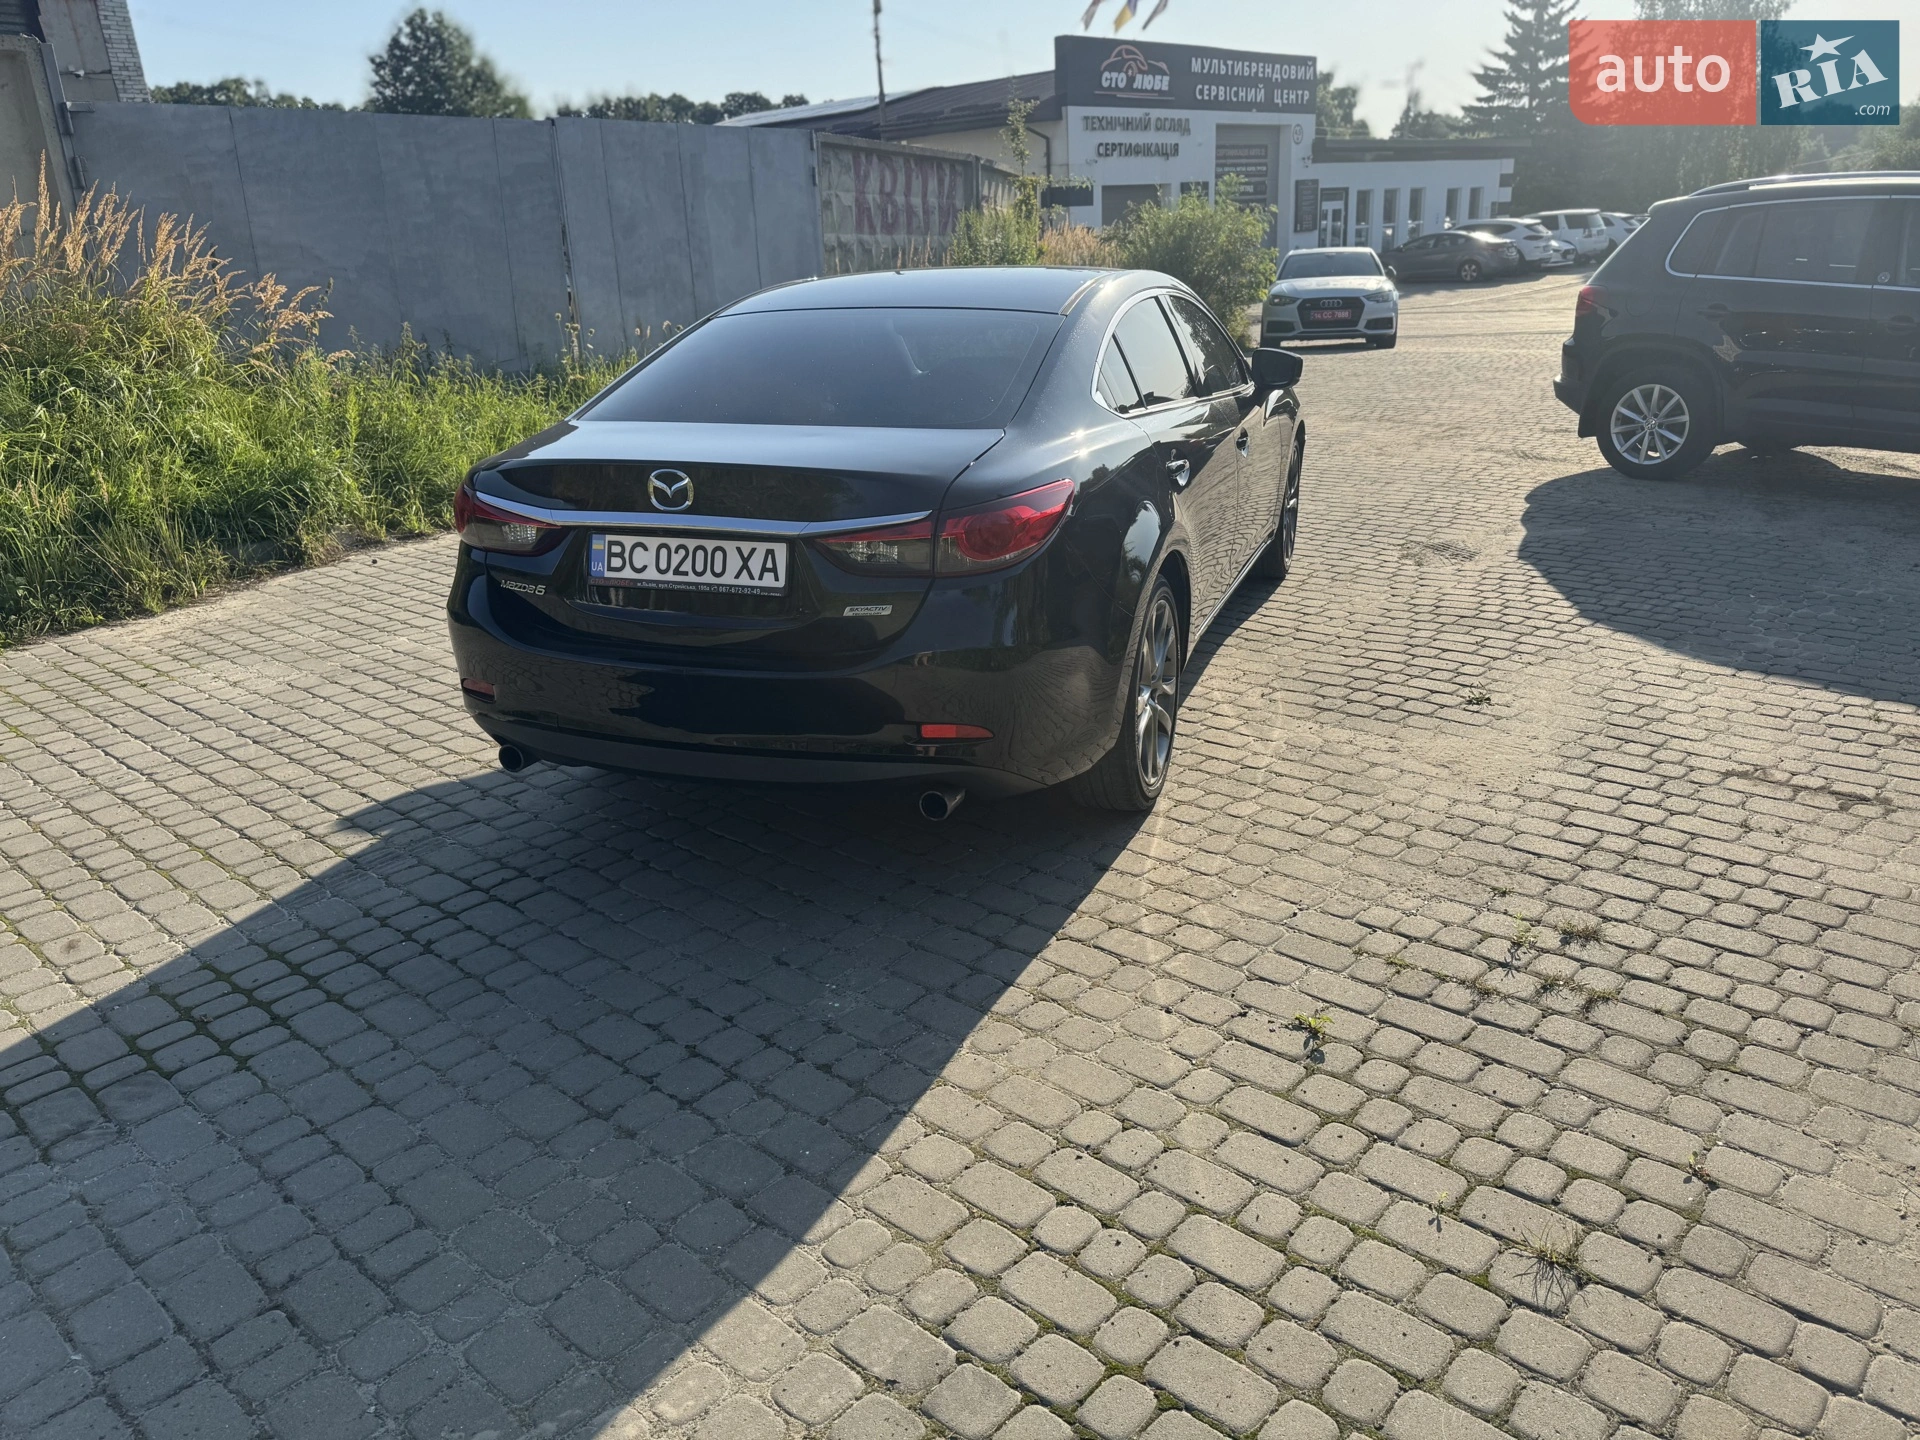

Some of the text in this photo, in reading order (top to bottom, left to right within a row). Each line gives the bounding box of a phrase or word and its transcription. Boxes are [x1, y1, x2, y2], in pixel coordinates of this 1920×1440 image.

[1101, 71, 1170, 91] СТО ЛЮБЕ
[1191, 57, 1314, 82] МУЛЬТИБРЕНДОВИЙ
[1195, 84, 1310, 107] СЕРВІСНИЙ ЦЕНТР
[1082, 112, 1191, 136] ТЕХНІЧНИЙ ОГЛЯД
[1096, 142, 1179, 160] СЕРТИФІКАЦІЯ
[591, 561, 604, 572] UA
[606, 540, 780, 582] BC 0200 XA
